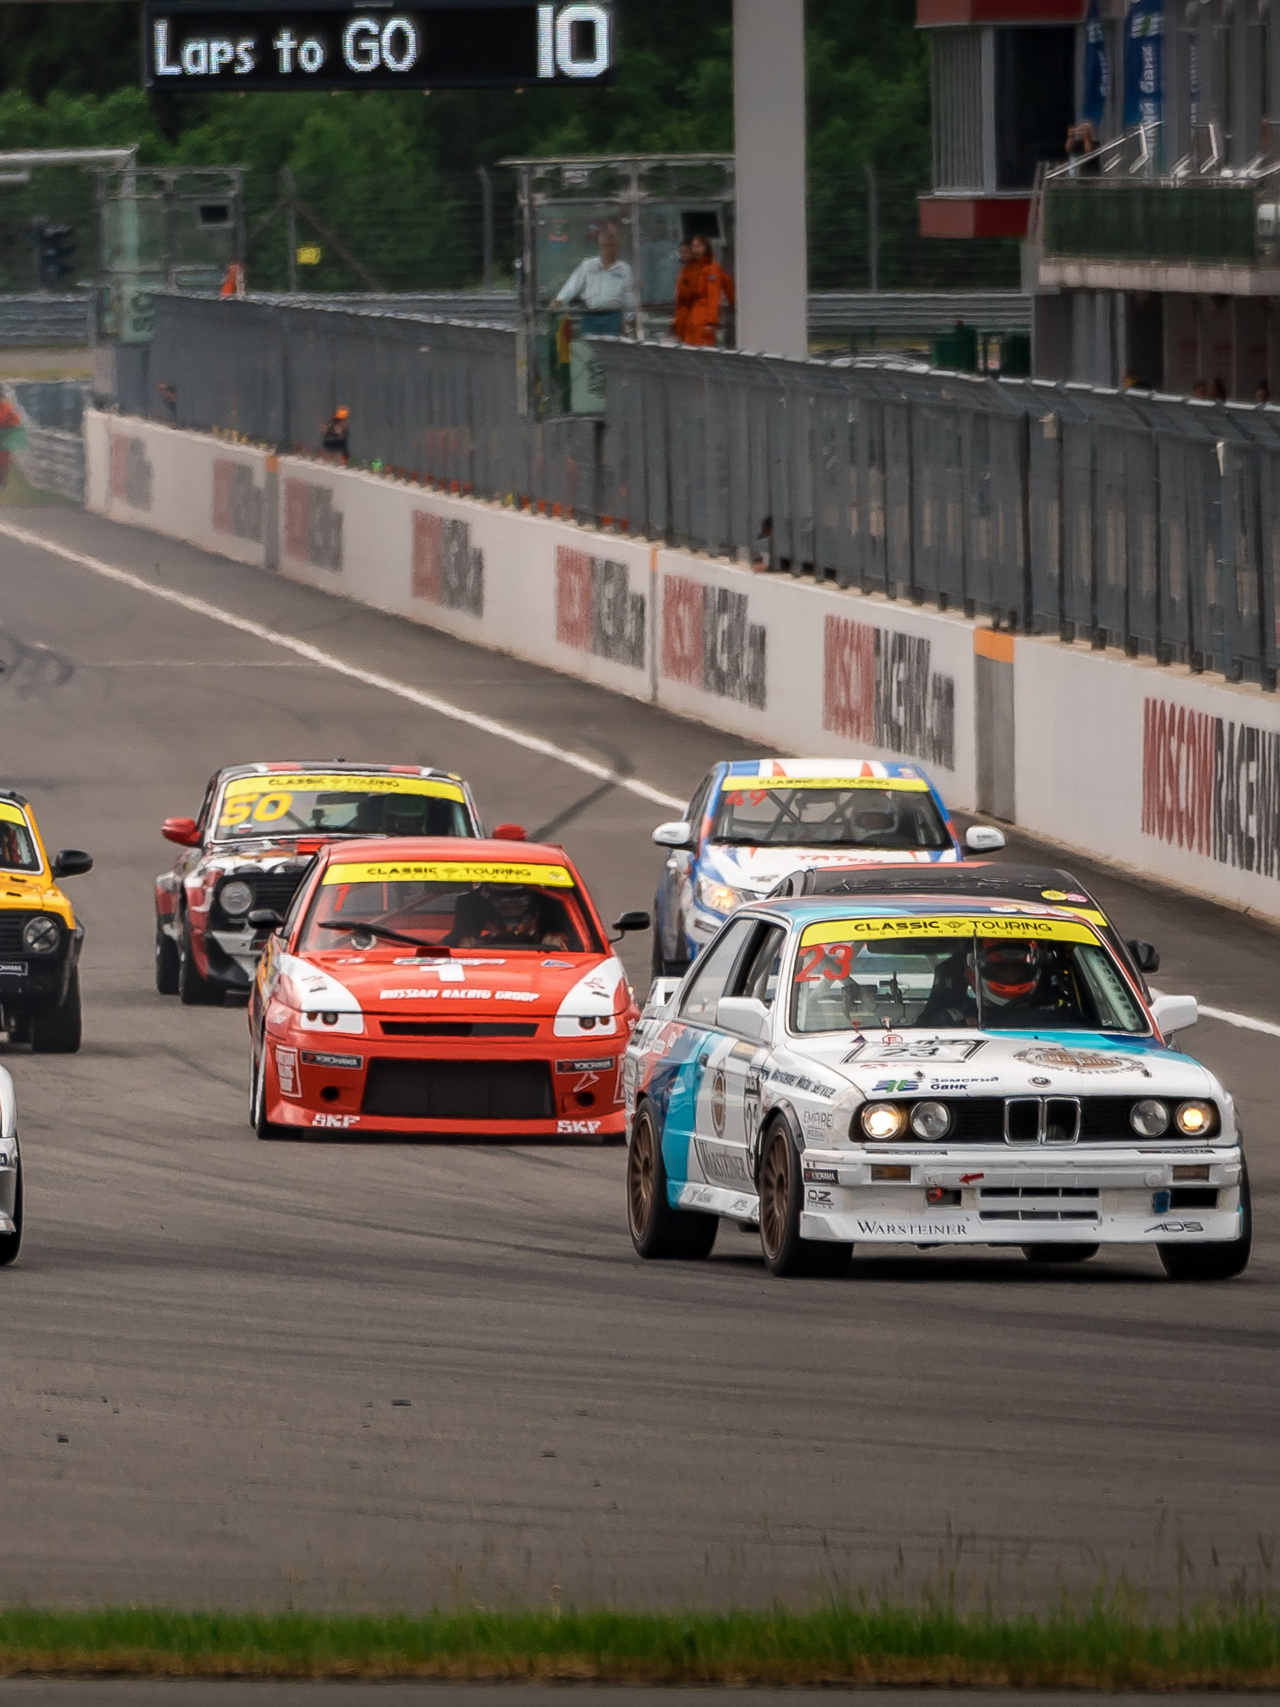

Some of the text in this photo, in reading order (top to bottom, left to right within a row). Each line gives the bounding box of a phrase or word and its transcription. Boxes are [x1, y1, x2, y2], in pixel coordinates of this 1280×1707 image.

[154, 3, 613, 78] Laps to GO 10
[268, 778, 325, 786] CLASSIC
[1142, 697, 1215, 857] MOSCOW
[219, 792, 293, 826] 50
[367, 867, 438, 875] CLASSIC
[464, 867, 532, 877] TOURING
[853, 919, 1053, 932] CLASSIC TOURING
[795, 944, 854, 983] 23
[379, 988, 540, 1002] RUSSIAN RACING GROUP
[930, 1083, 969, 1091] банк
[312, 1112, 361, 1129] SKF
[803, 1110, 833, 1128] EMPIRE
[556, 1120, 602, 1134] SKF
[808, 1189, 832, 1203] OZ
[857, 1219, 968, 1236] WARSTEINER
